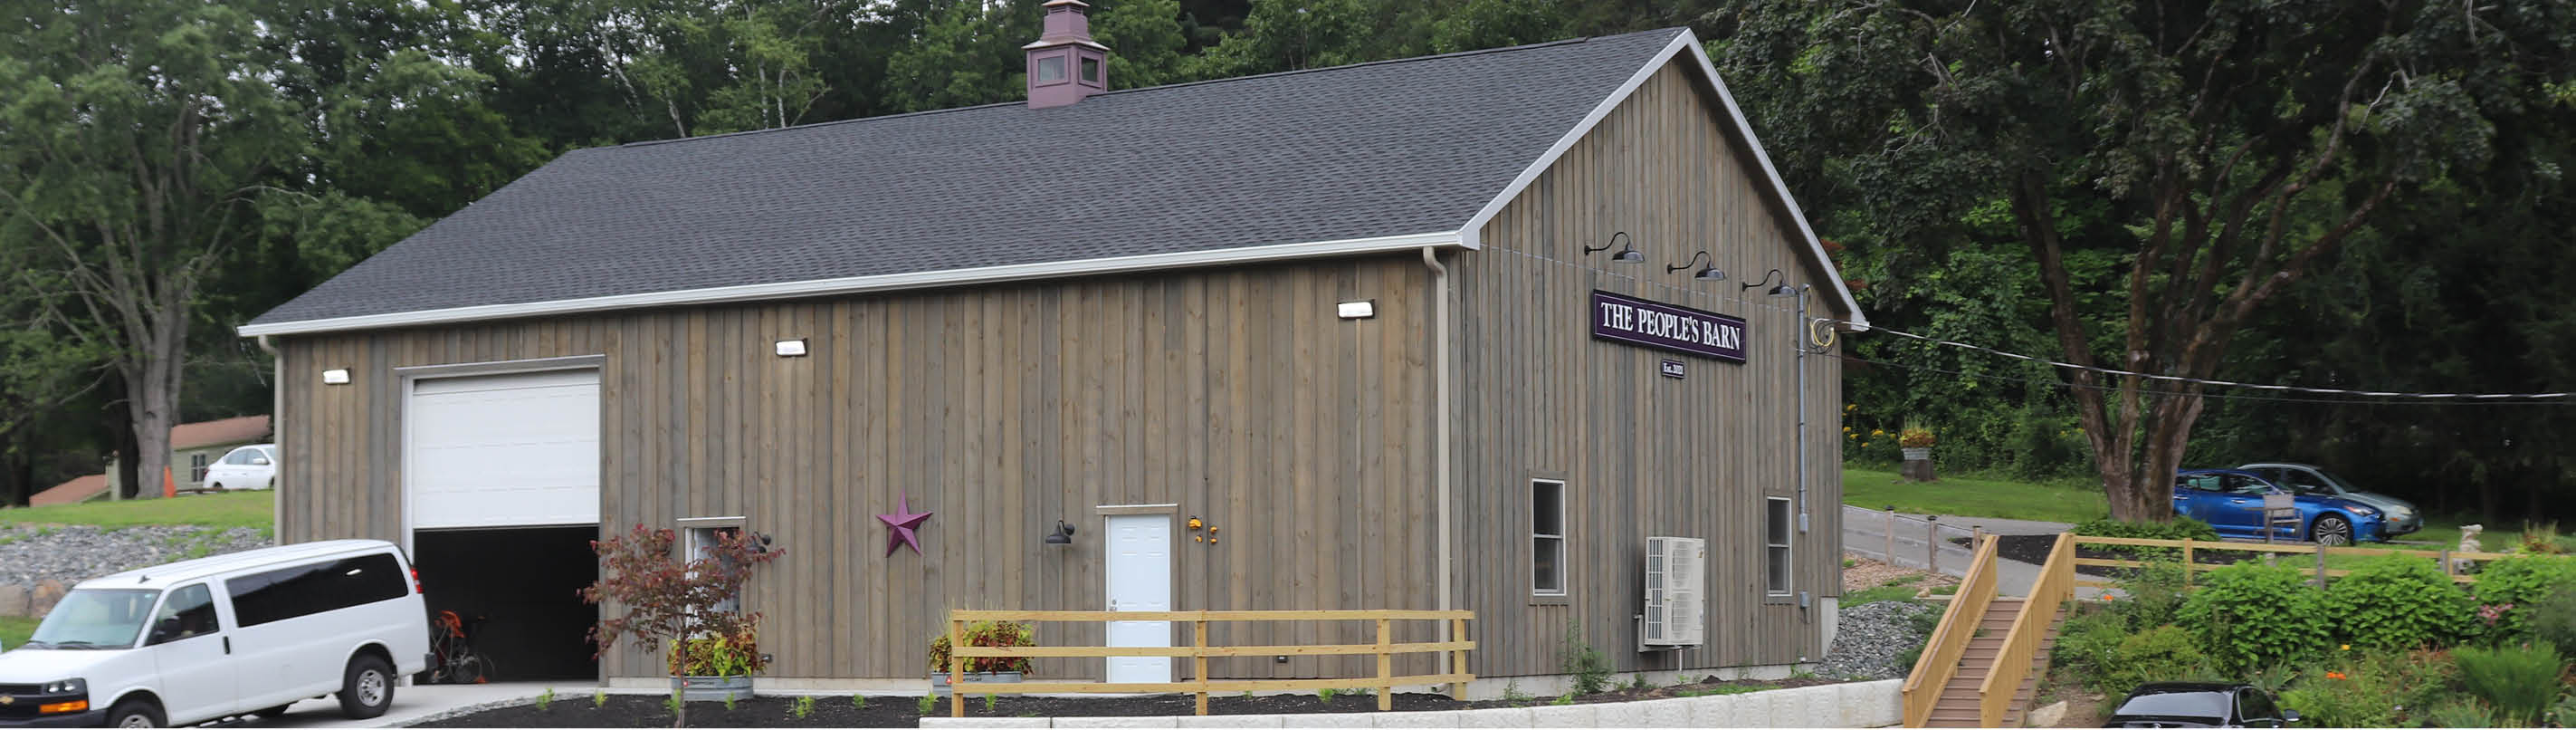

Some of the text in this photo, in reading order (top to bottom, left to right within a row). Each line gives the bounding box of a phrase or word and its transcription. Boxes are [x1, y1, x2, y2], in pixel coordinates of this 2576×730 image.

[1601, 302, 1741, 351] THE PEOPLE'S BARN
